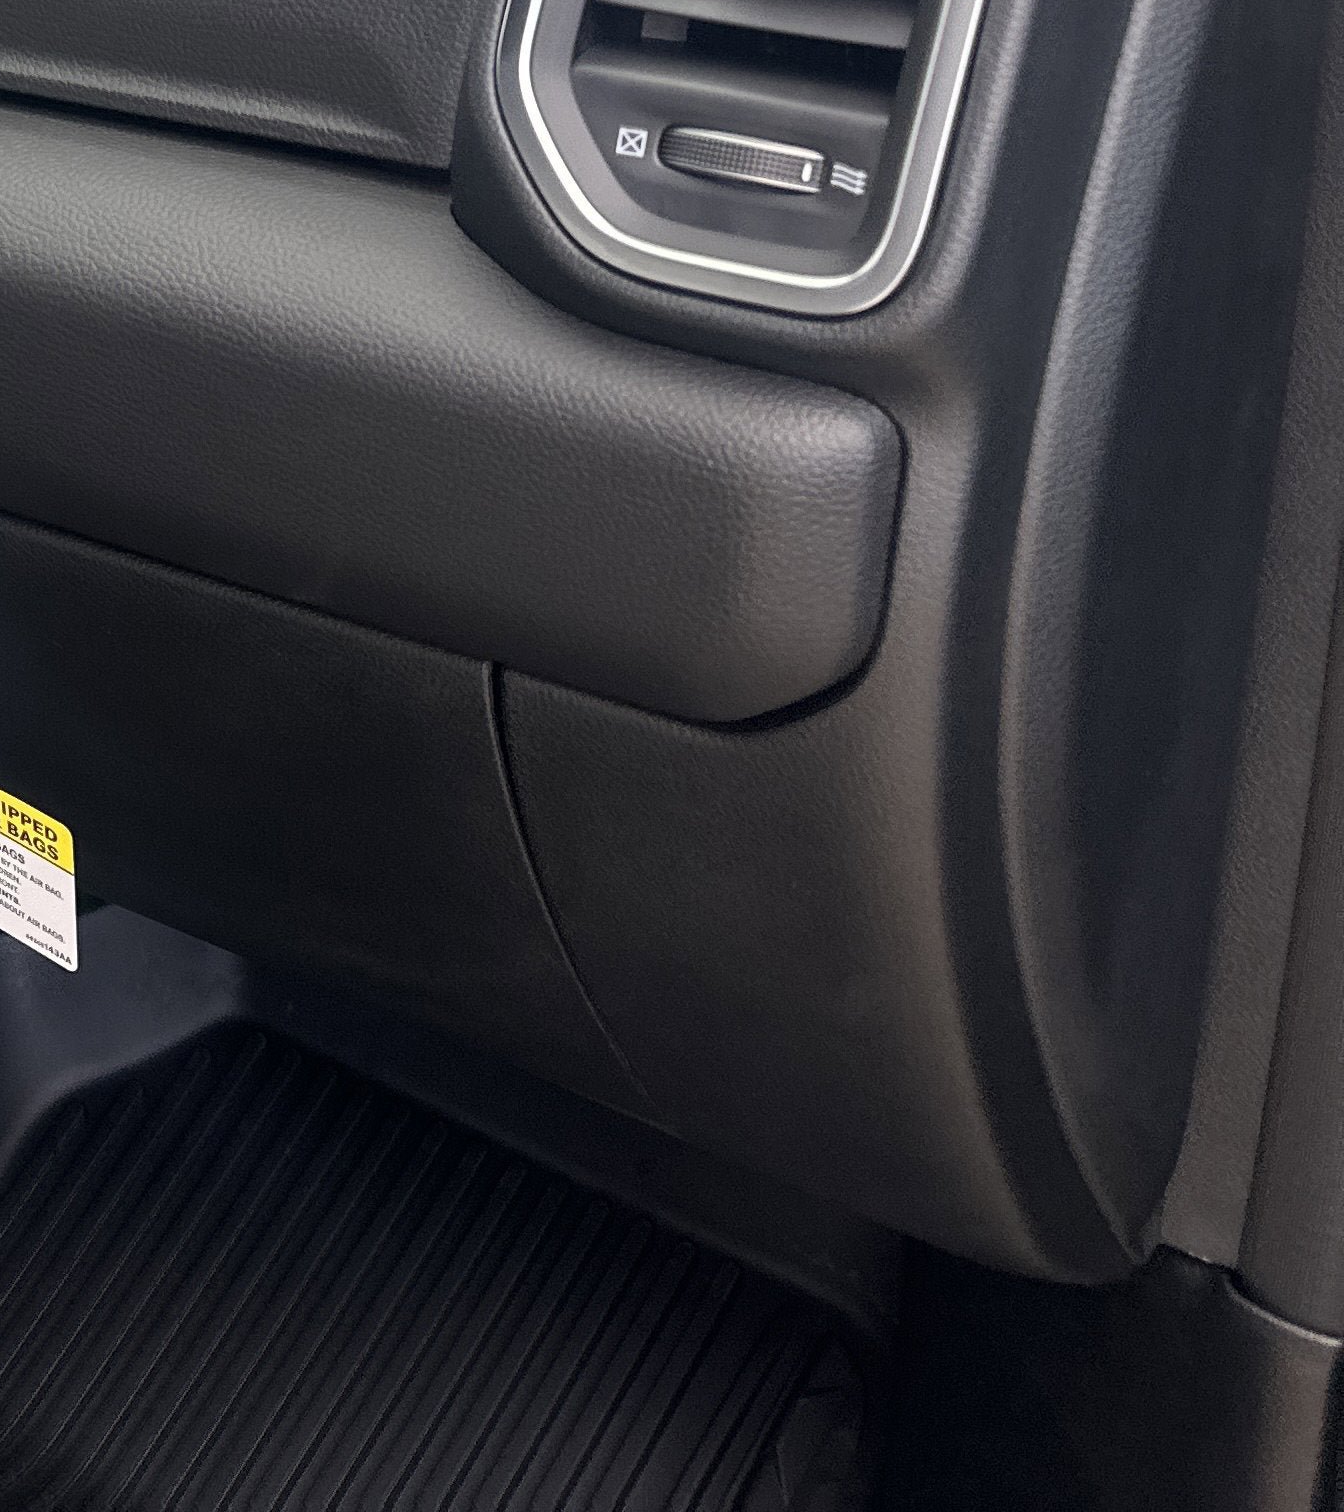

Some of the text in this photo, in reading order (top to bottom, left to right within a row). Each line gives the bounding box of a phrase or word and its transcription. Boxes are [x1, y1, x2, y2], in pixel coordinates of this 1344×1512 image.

[7, 820, 58, 861] BAGS
[13, 864, 28, 879] THE
[30, 875, 43, 889] AIR
[0, 898, 25, 920] ABOUT
[27, 915, 40, 929] AIR
